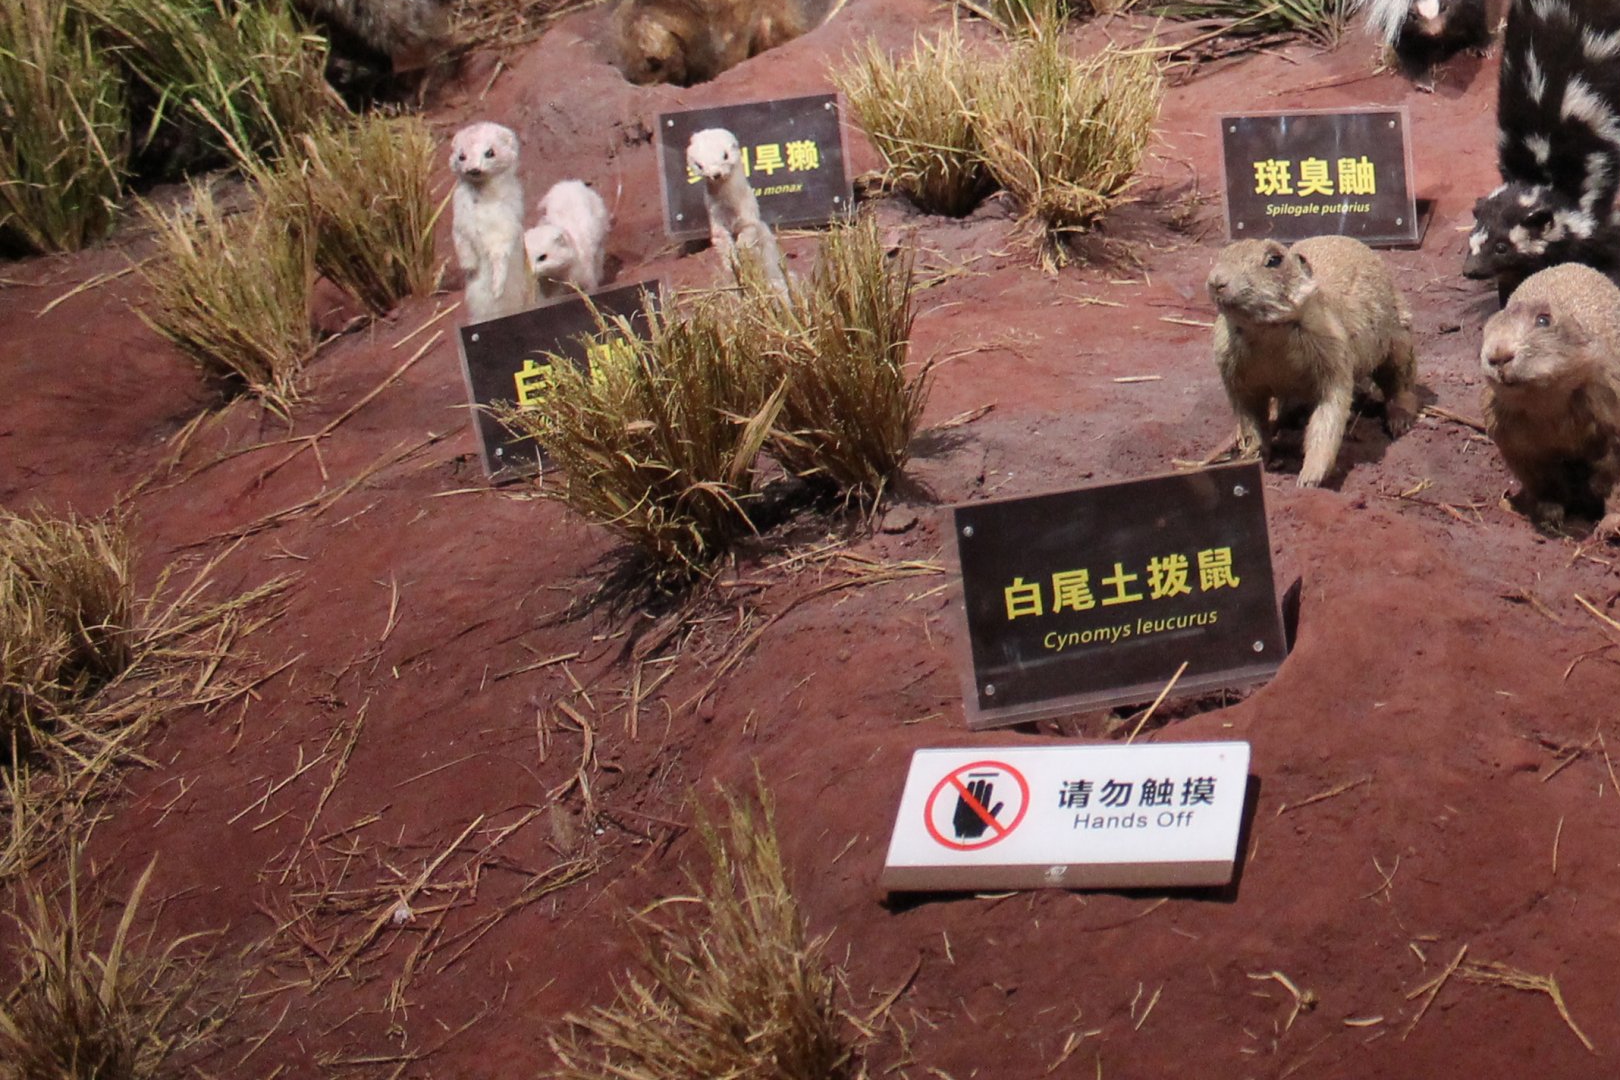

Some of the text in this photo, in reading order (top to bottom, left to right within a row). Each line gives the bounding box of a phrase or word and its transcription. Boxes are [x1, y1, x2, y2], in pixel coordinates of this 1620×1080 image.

[763, 183, 803, 196] monax
[1253, 155, 1377, 197] 斑臭鼬
[1266, 201, 1371, 217] Spilogale putorius
[1004, 546, 1241, 620] 白尾土拨鼠
[1043, 610, 1219, 652] Cynomys leucurus
[1057, 776, 1218, 809] 请勿触摸
[1073, 810, 1194, 830] Hands Off
